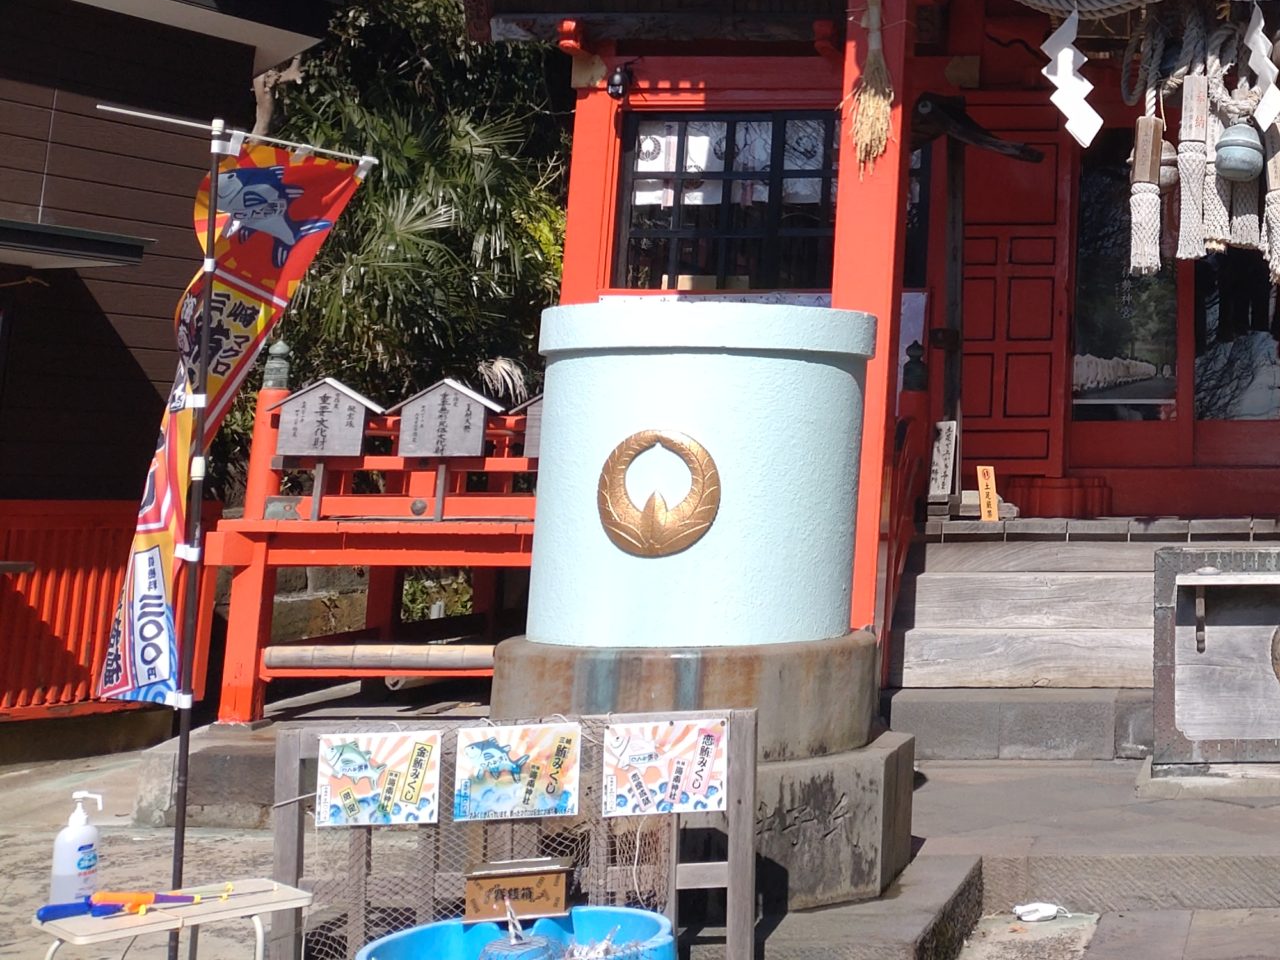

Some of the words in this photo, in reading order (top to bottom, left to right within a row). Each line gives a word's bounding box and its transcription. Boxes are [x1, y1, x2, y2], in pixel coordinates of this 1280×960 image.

[312, 392, 333, 451] 重要文化財
[984, 482, 994, 519] 土足厳禁
[404, 746, 428, 801] 金鮪みくじ
[692, 734, 715, 790] 恋鮪みくじ
